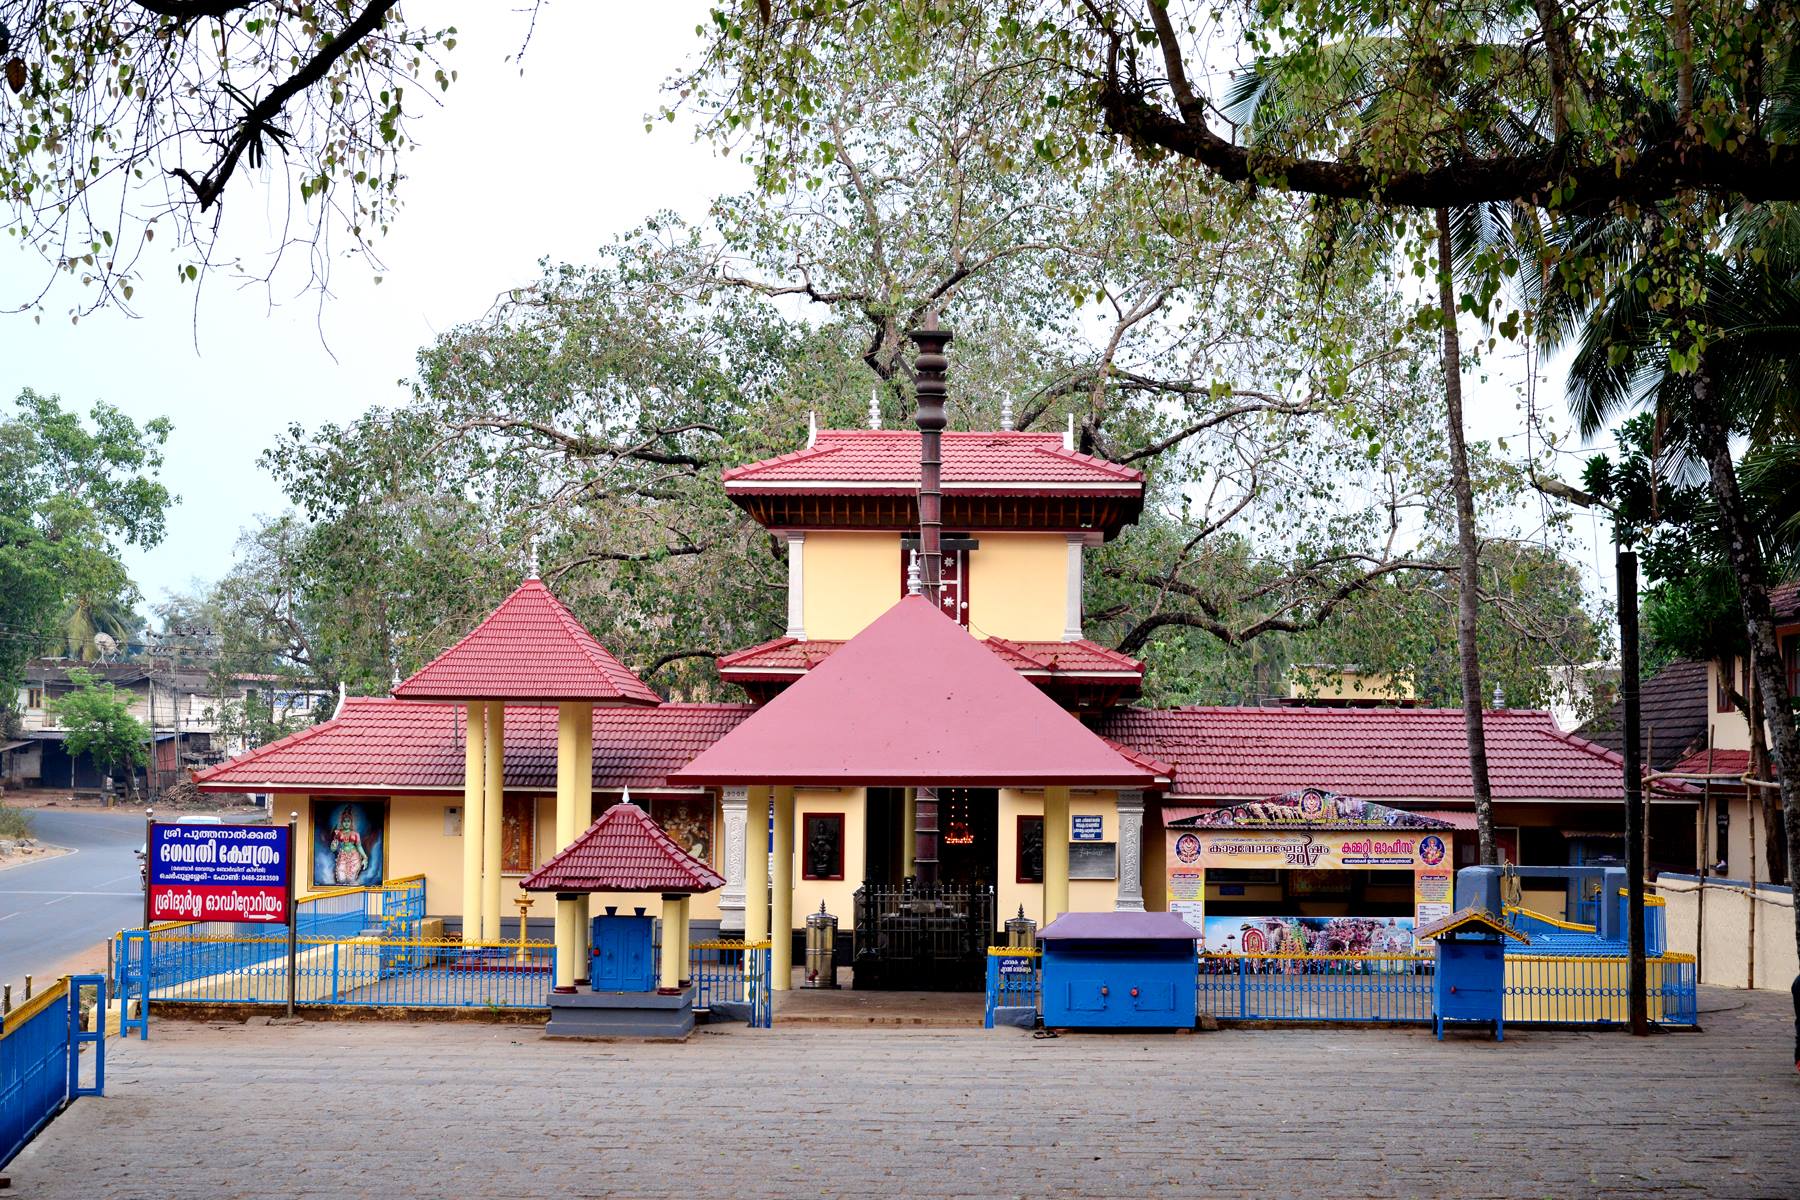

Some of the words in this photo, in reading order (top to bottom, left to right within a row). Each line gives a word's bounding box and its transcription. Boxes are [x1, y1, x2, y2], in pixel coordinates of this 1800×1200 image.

[163, 828, 181, 840] ശ്രീ
[184, 829, 277, 841] പുത്തനാൽക്കൽ
[160, 839, 217, 863] ഭഗവതി
[219, 844, 280, 867] ക്ഷേത്രം
[1341, 839, 1372, 858] കമ്മറ്റി
[1374, 838, 1416, 855] ഓഫീസ്
[206, 890, 283, 918] ഓഡിറ്റോറിയം
